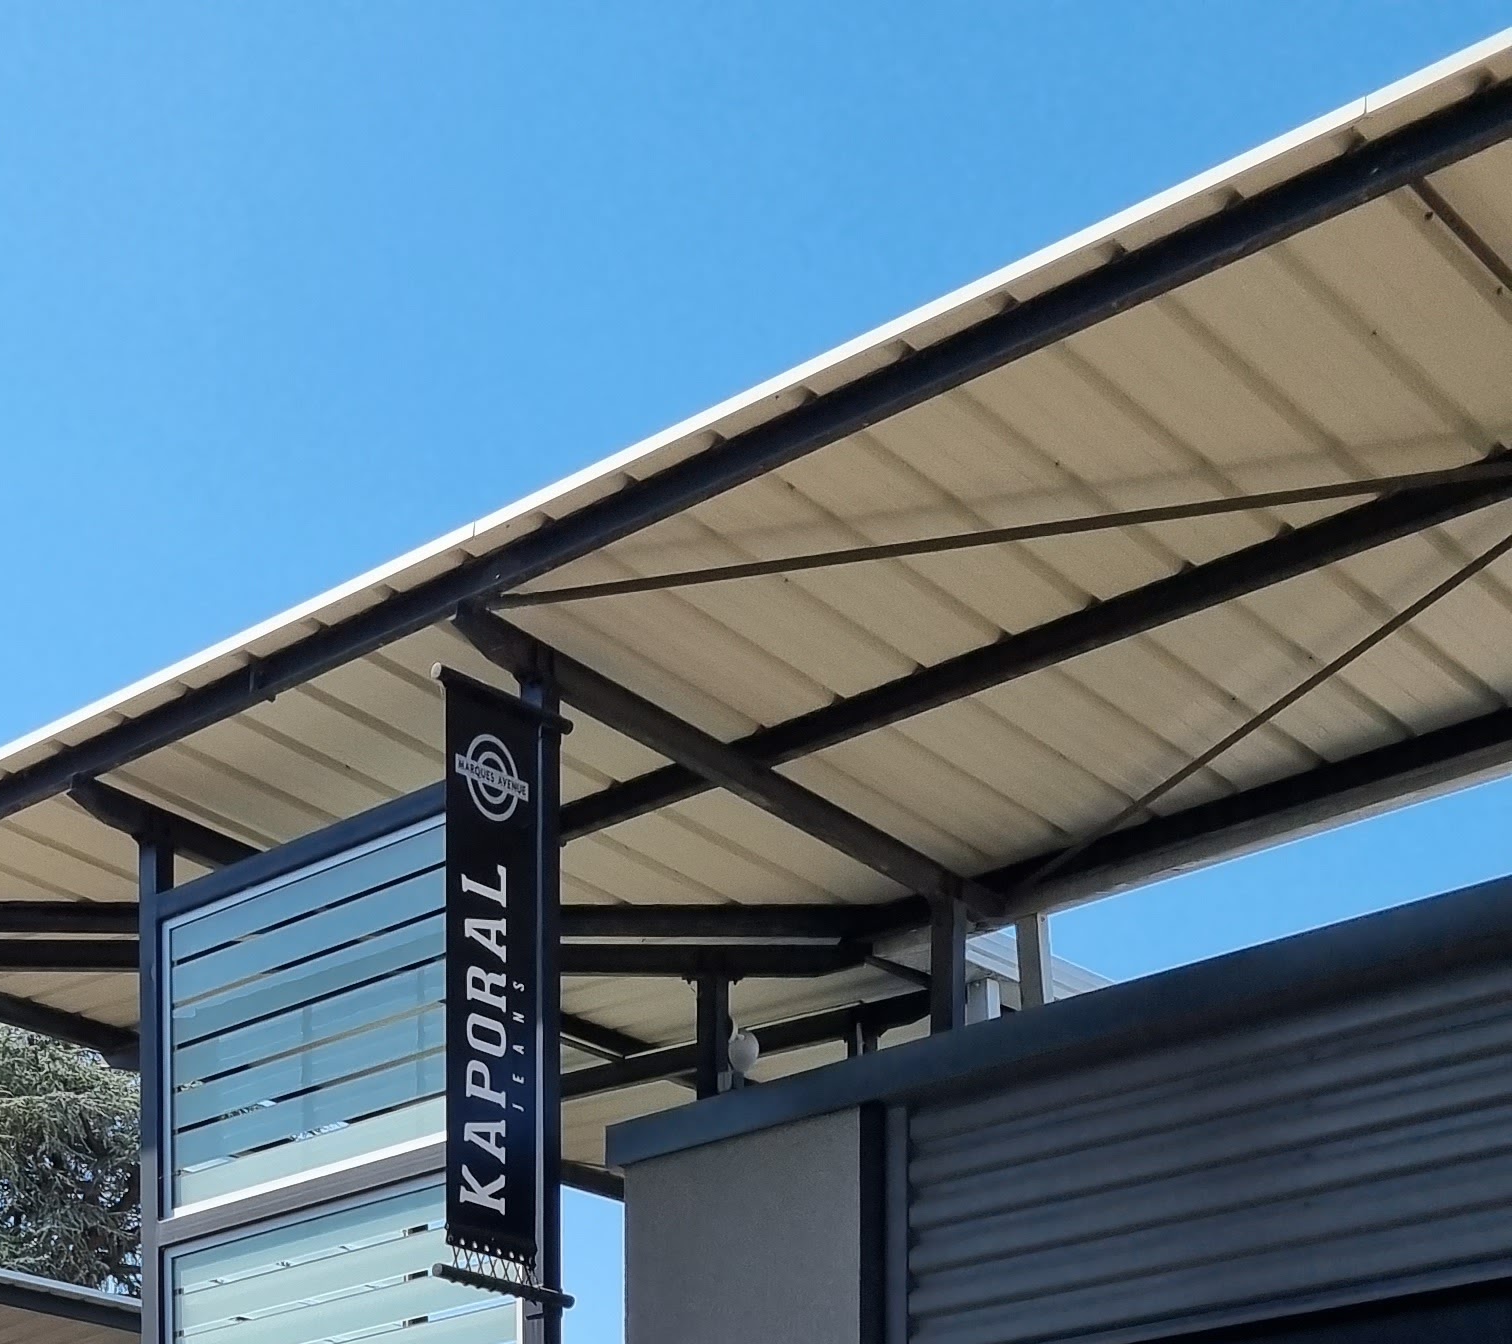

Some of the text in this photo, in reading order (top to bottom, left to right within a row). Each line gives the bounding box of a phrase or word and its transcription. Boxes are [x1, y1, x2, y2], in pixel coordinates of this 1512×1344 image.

[458, 760, 528, 797] MARQUES AVENUE
[459, 863, 509, 1217] KAPORAL
[512, 980, 526, 1113] JEANS
